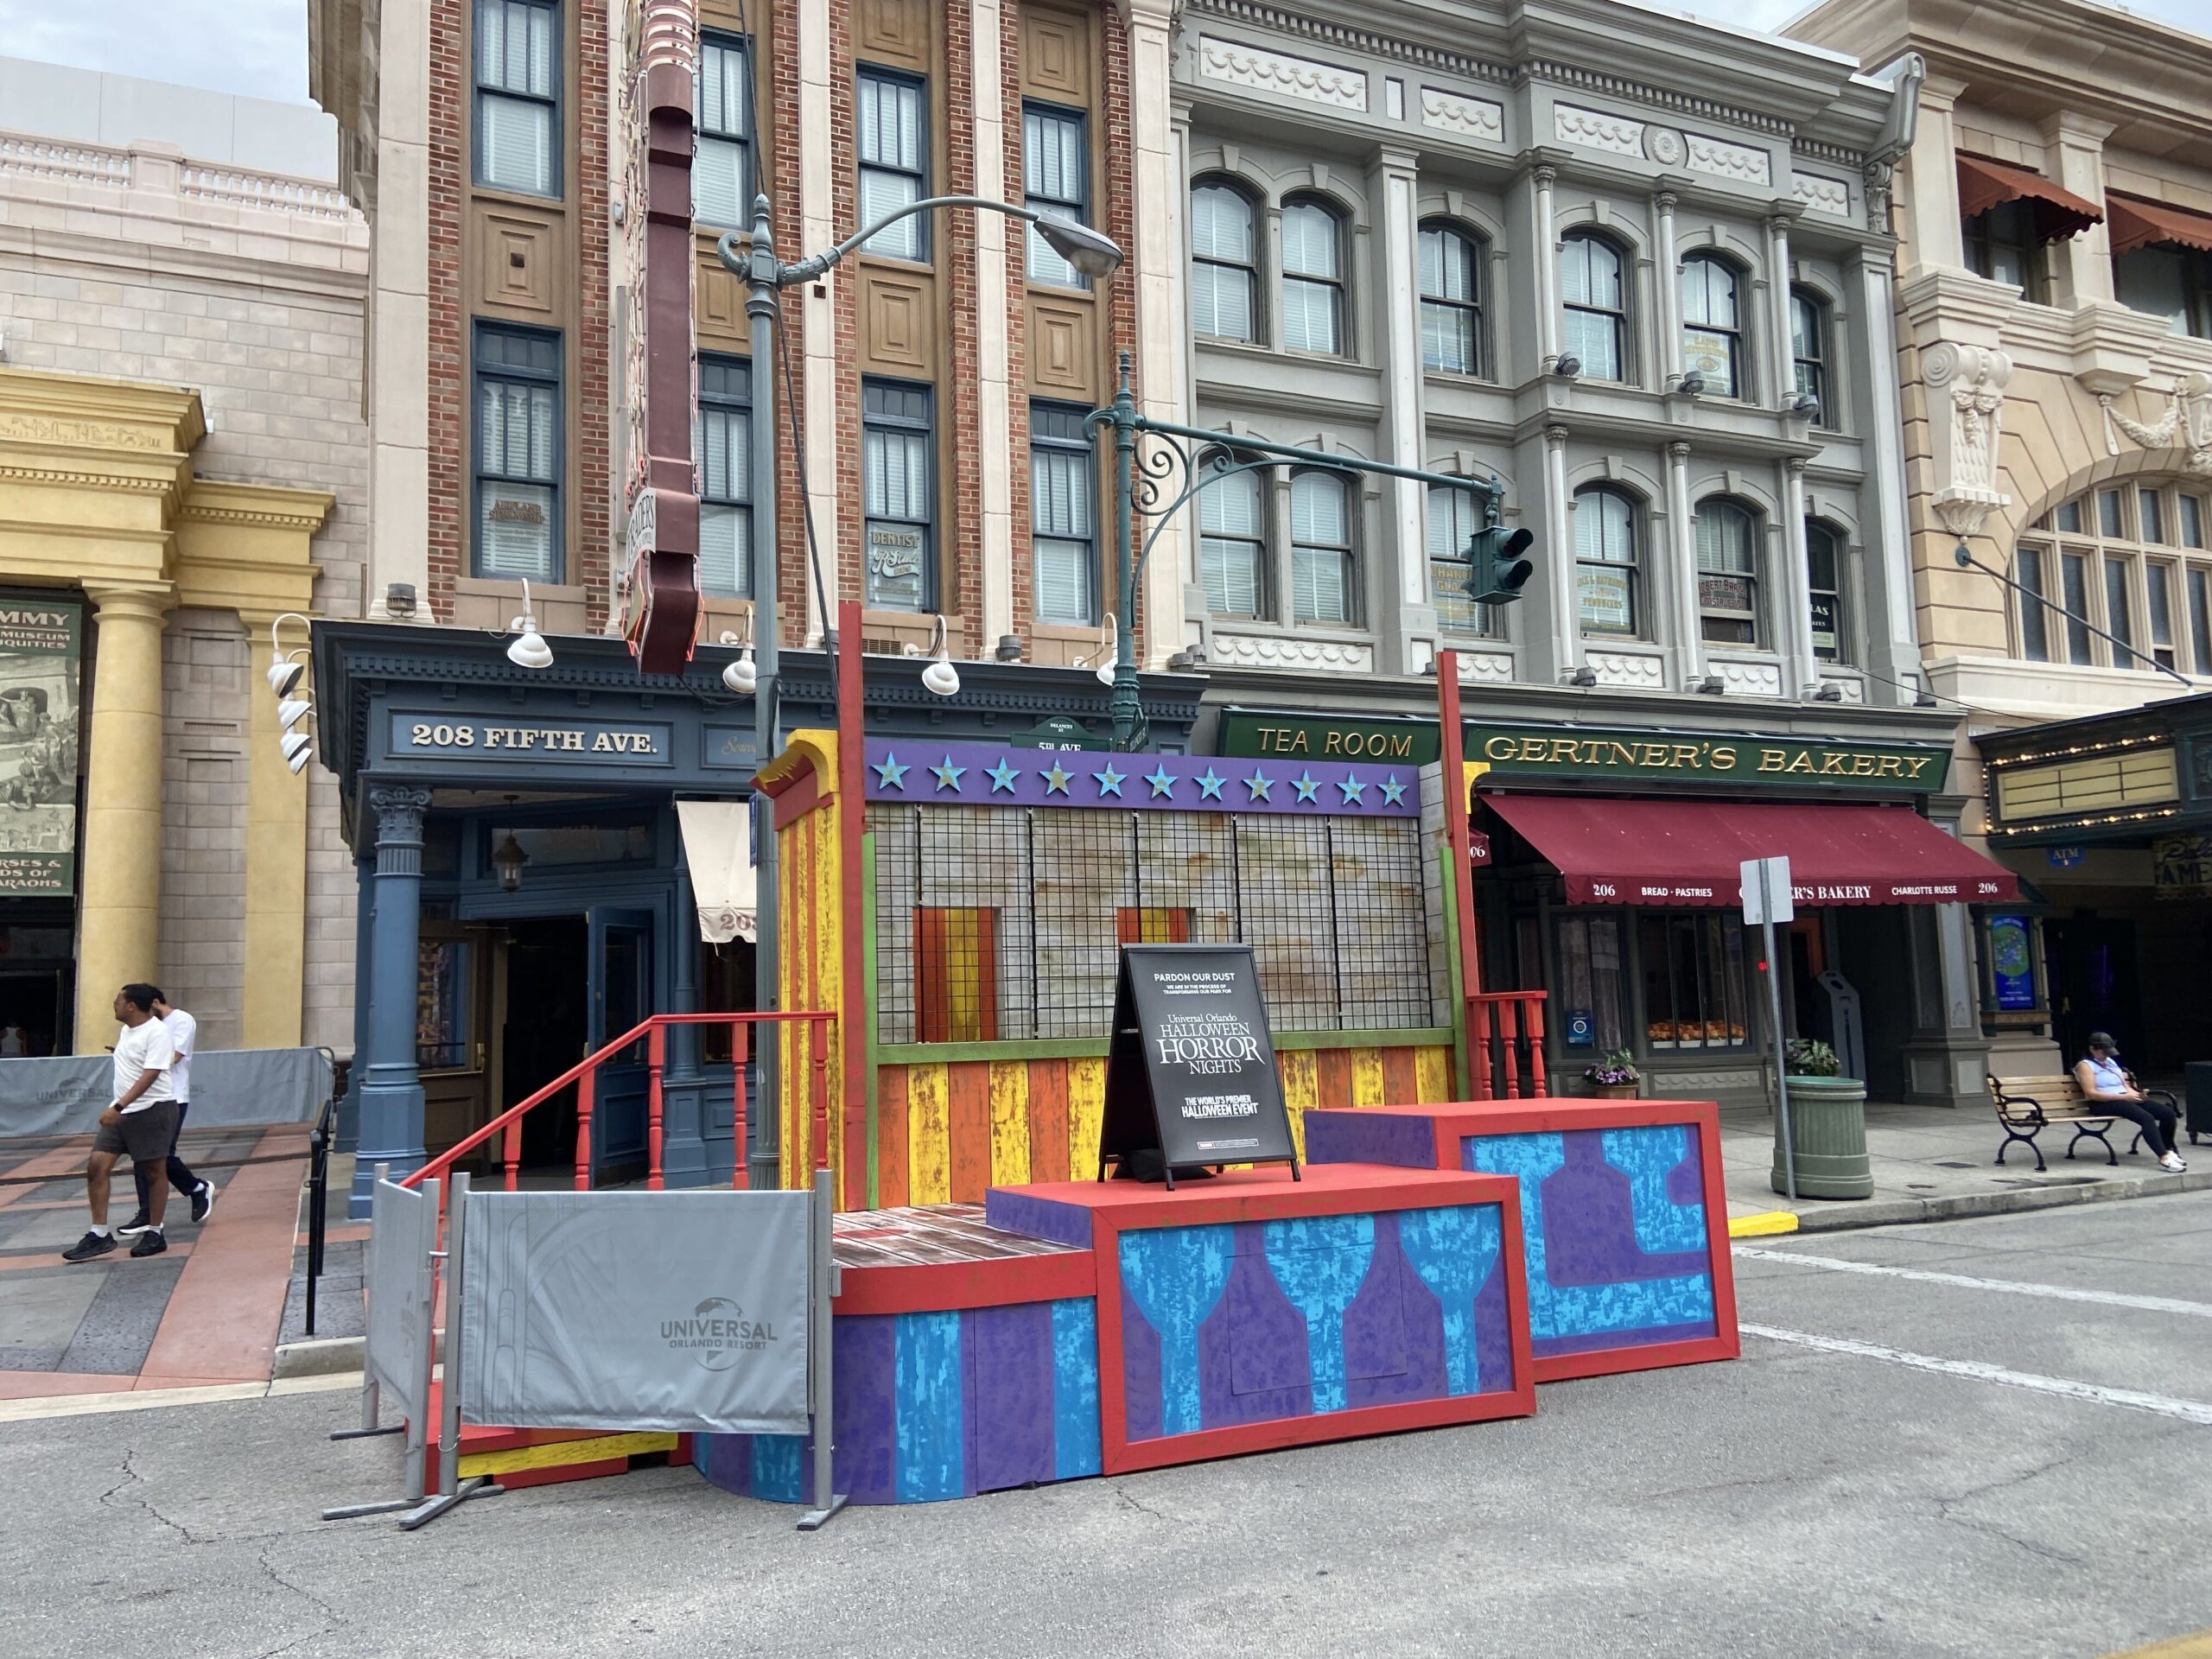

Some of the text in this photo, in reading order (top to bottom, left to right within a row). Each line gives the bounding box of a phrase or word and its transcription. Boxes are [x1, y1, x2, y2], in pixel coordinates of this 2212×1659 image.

[871, 531, 919, 549] DENTIST
[1, 632, 70, 641] MUSEUM
[412, 723, 658, 754] 208 FIFTH AVE.
[1257, 728, 1412, 758] TEA ROOM
[1039, 741, 1054, 750] 5TH
[1484, 735, 1931, 779] GERTNER'S BAKERY
[1470, 845, 1485, 858] 06
[2053, 848, 2079, 860] ATM
[48, 860, 62, 868] &
[1592, 884, 1616, 897] 206
[1641, 887, 1713, 897] BREAD PASTRIES
[1818, 886, 1872, 899] BAKERY
[1891, 886, 1957, 896] CHARLOTTE RUSSE
[1978, 882, 1998, 893] 206
[1154, 972, 1235, 982] PARDON OUR DUST
[1167, 1013, 1237, 1023] Universal Orlando
[1160, 1022, 1250, 1038] HALLOWEEN
[1155, 1036, 1265, 1065] HORROR
[1188, 1058, 1242, 1075] NIGHTS
[1185, 1094, 1251, 1106] THE WORLD'S PREMIER
[1181, 1103, 1258, 1118] HALLOWEEN EVENT
[661, 1319, 778, 1341] UNIVERSAL
[670, 1338, 767, 1351] ORLANDO RESORT
